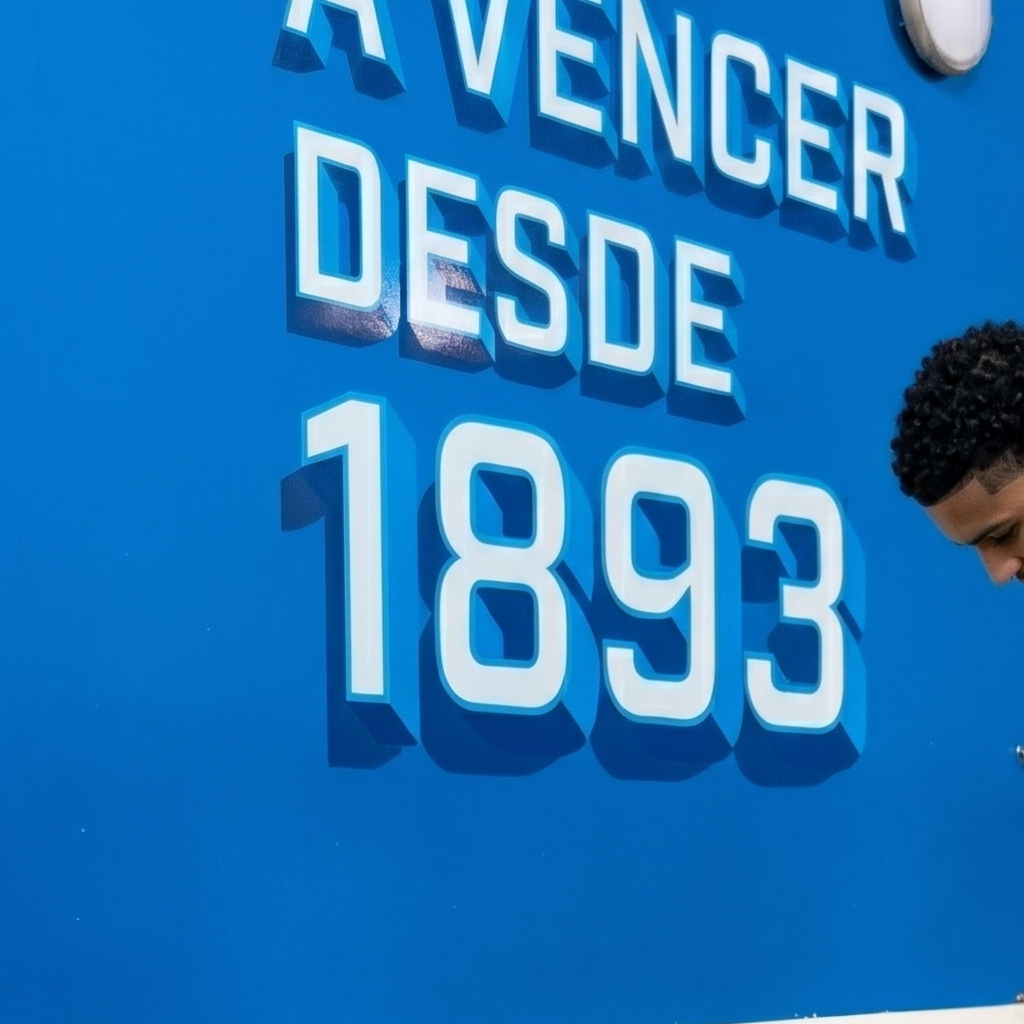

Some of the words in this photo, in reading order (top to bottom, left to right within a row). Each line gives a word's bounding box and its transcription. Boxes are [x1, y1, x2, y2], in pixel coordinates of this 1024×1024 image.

[449, 0, 907, 233] VENCER
[296, 125, 733, 394] DESDE
[306, 399, 844, 730] 1893
